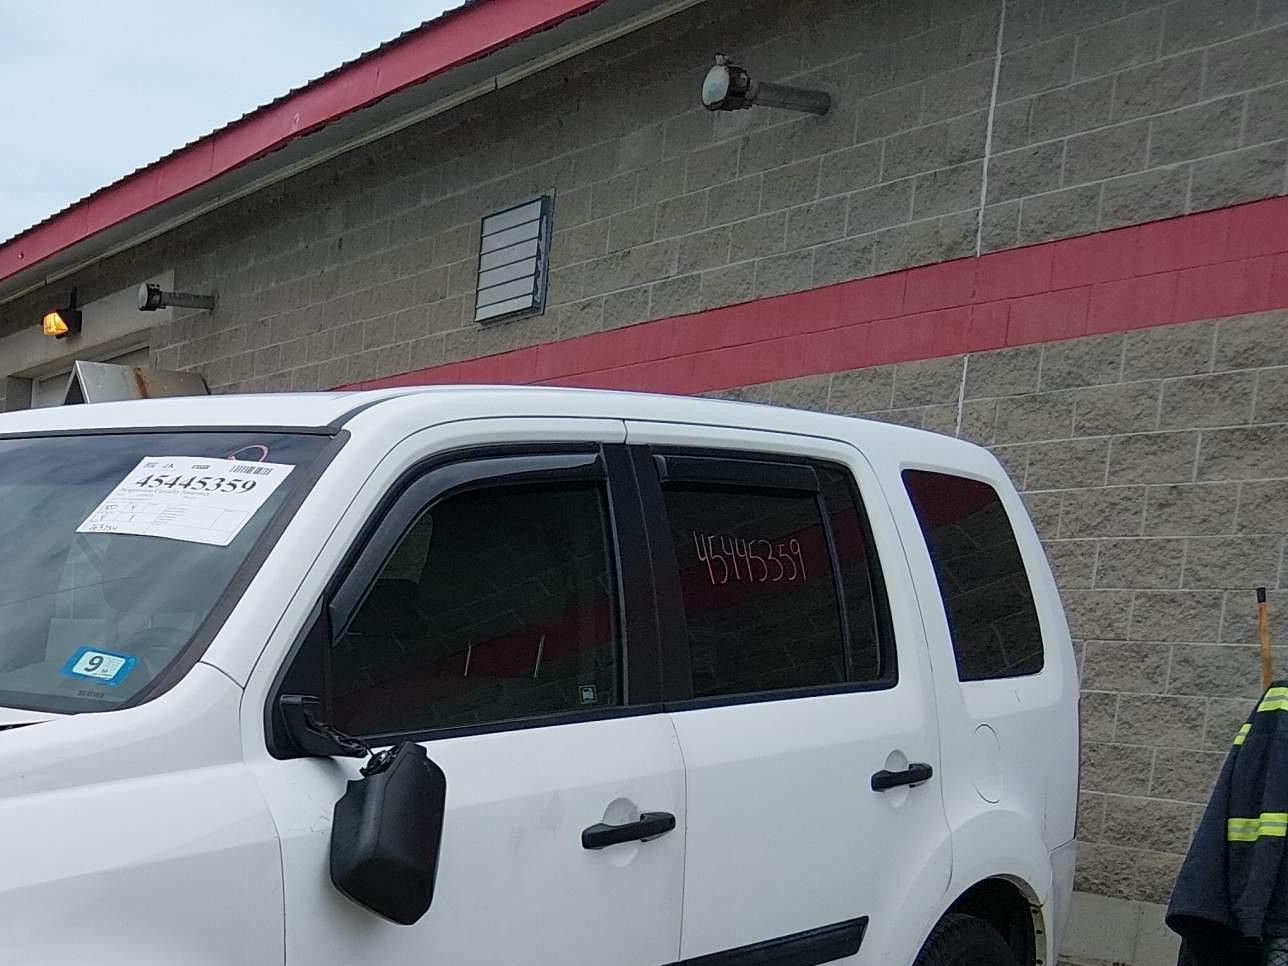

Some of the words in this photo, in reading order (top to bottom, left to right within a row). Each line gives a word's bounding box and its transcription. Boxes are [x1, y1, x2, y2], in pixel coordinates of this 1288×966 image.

[135, 473, 258, 494] 45445359
[692, 530, 807, 585] 45445359
[83, 655, 104, 672] 9
